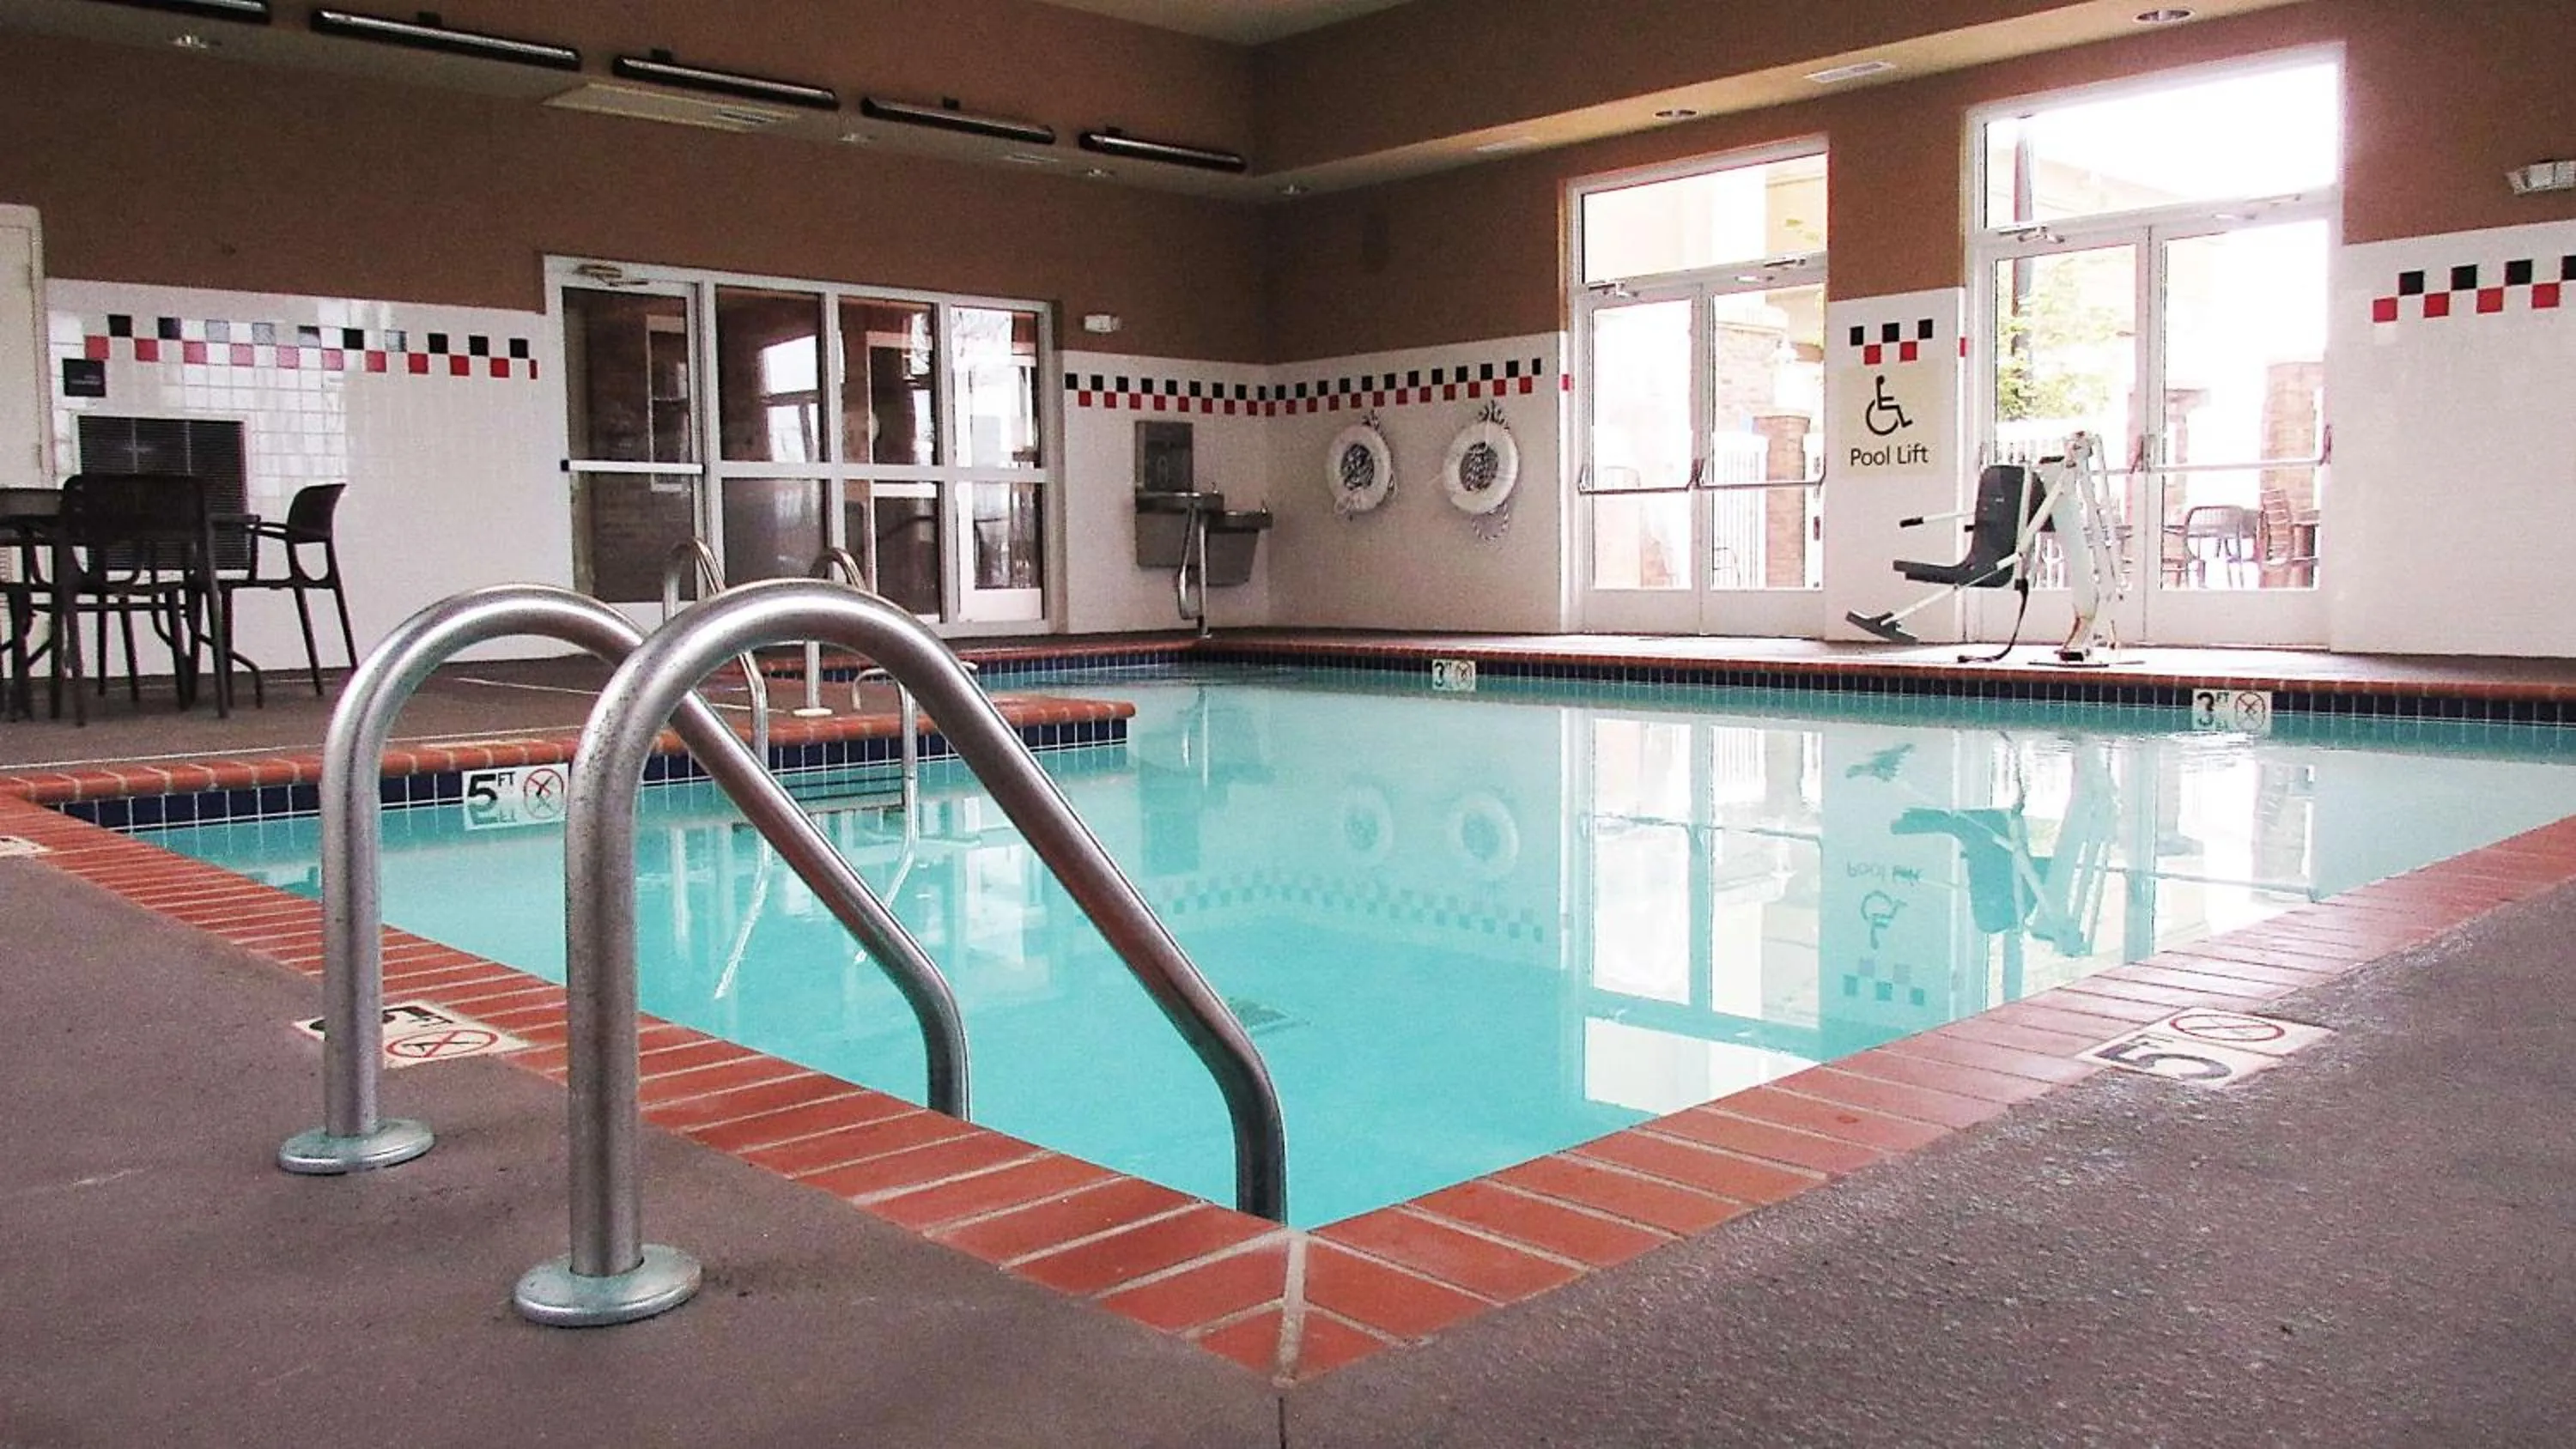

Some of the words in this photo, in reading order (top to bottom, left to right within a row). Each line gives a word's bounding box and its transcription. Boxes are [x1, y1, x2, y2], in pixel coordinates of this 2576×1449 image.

[1850, 446, 1890, 467] Pool
[1897, 443, 1929, 464] Lift
[467, 773, 498, 812] 5
[497, 772, 516, 787] FT
[2093, 1042, 2233, 1080] 5
